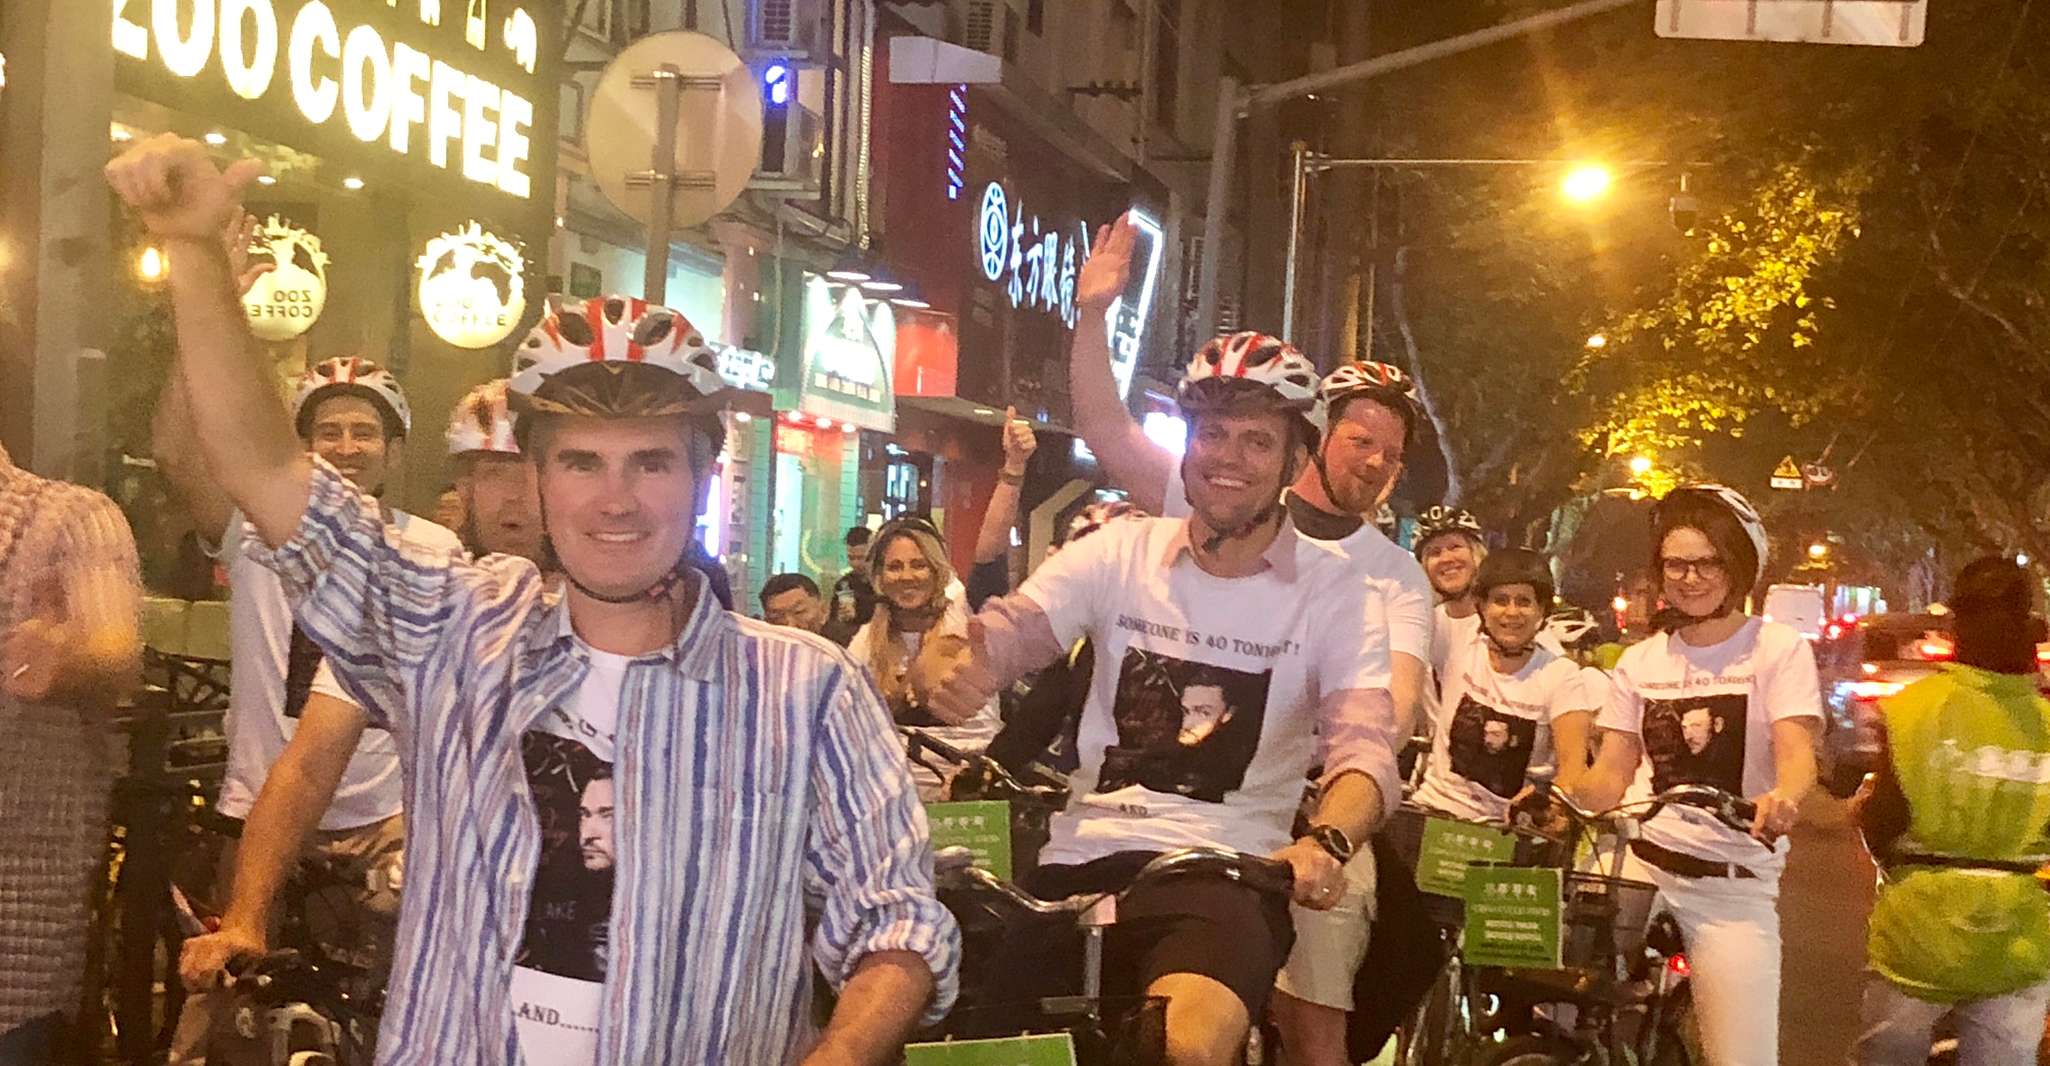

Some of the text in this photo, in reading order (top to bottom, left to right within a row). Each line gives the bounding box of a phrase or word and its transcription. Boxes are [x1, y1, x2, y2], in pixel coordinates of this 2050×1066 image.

[288, 0, 533, 199] COFFEE
[1116, 614, 1181, 642] SOMEONE
[1185, 631, 1200, 645] IS
[1206, 633, 1228, 650] 40
